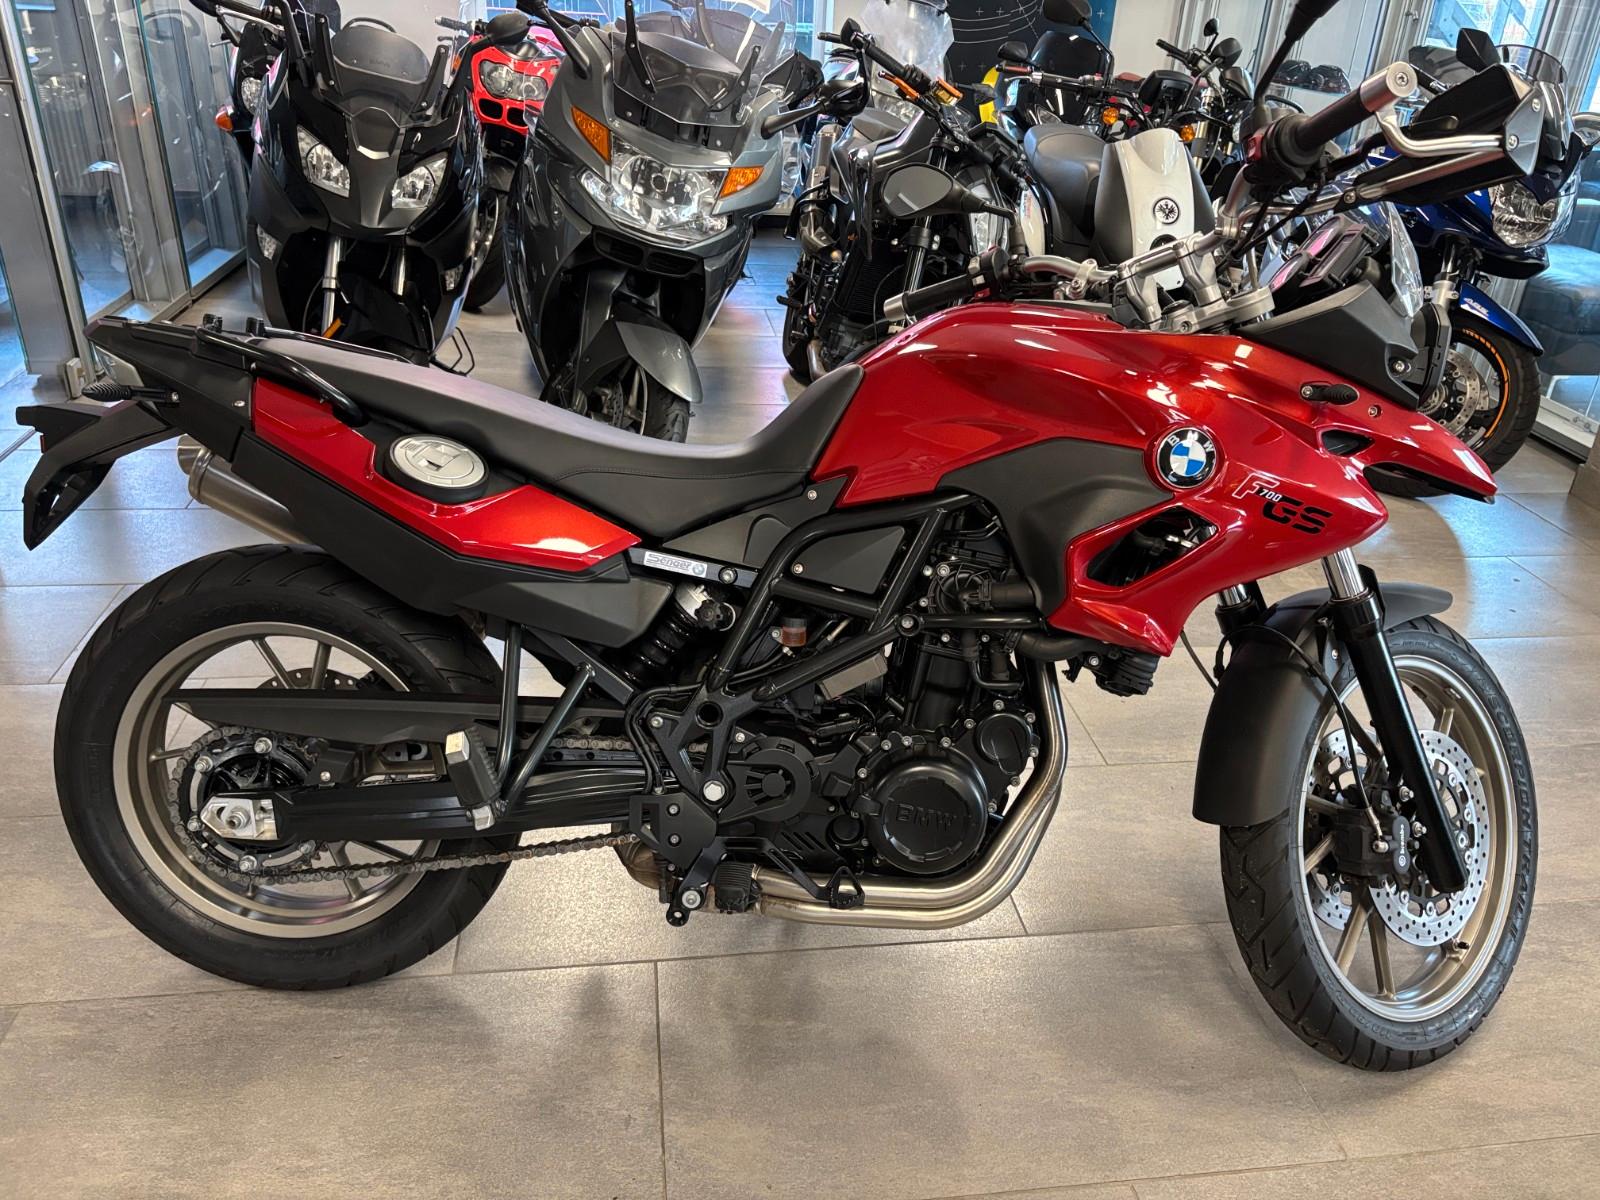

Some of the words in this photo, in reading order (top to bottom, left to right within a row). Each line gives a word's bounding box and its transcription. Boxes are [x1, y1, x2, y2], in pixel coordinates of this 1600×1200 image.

[1167, 430, 1214, 452] BMW
[1232, 472, 1280, 499] F
[1260, 488, 1282, 502] 700
[1263, 494, 1333, 534] GS
[646, 553, 692, 570] Senger
[896, 802, 957, 832] BMW
[1488, 694, 1533, 831] SCORPION
[1516, 838, 1532, 914] TRAIL
